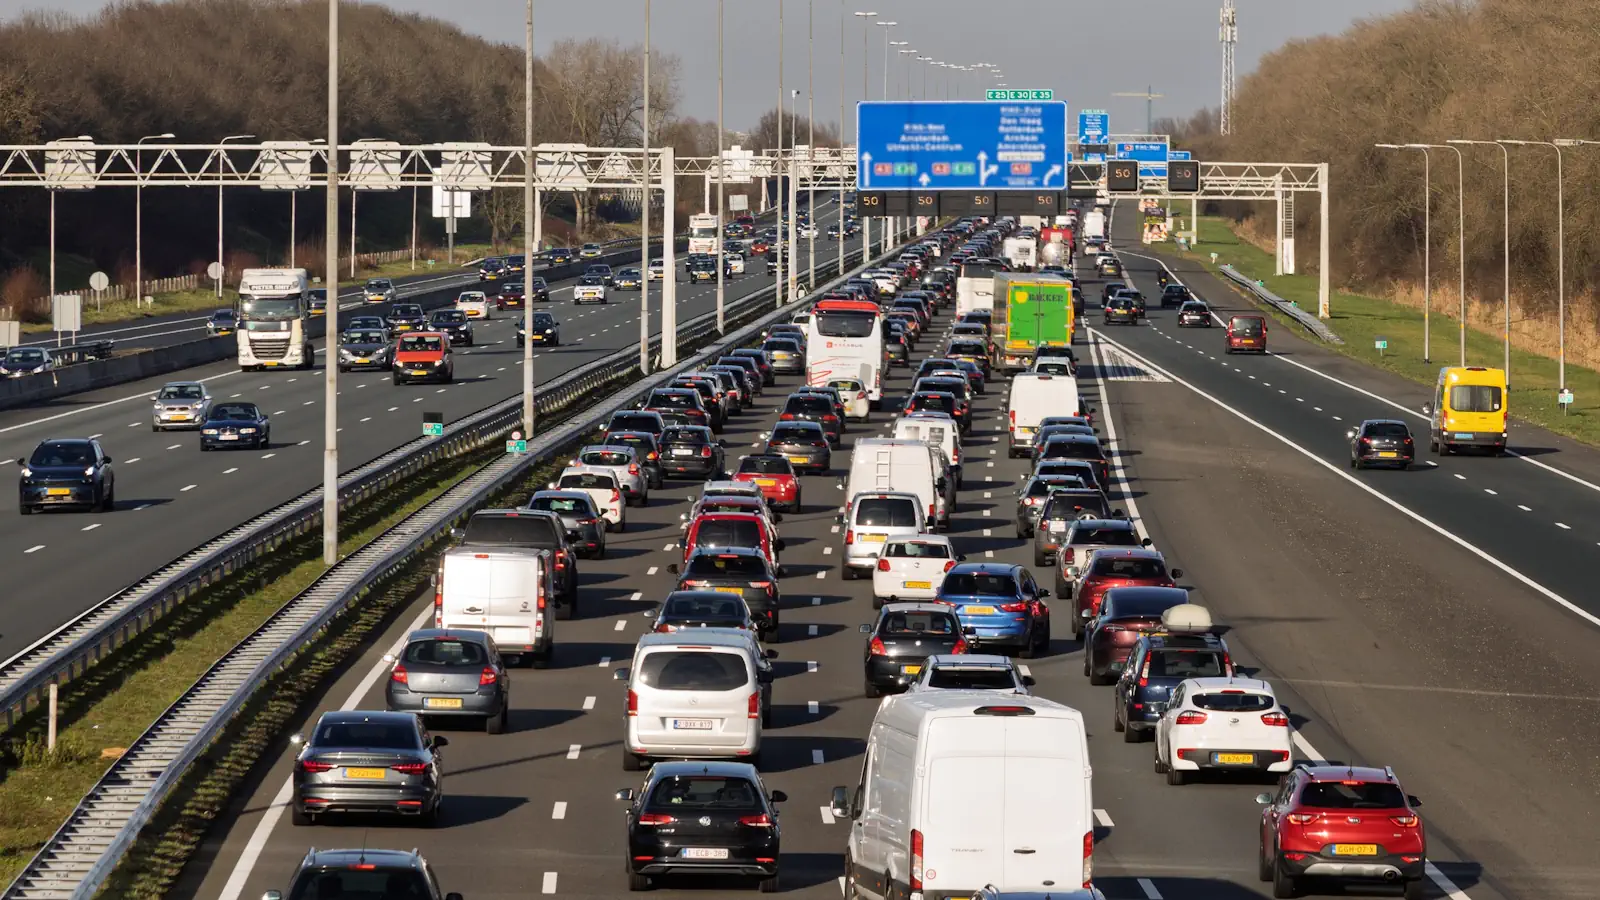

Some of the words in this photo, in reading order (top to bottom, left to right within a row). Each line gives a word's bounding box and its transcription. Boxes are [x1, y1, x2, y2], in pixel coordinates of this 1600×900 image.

[1115, 169, 1130, 178] 50
[863, 196, 879, 205] 50
[918, 196, 933, 205] 50
[974, 196, 989, 204] 50
[1038, 196, 1052, 204] 50
